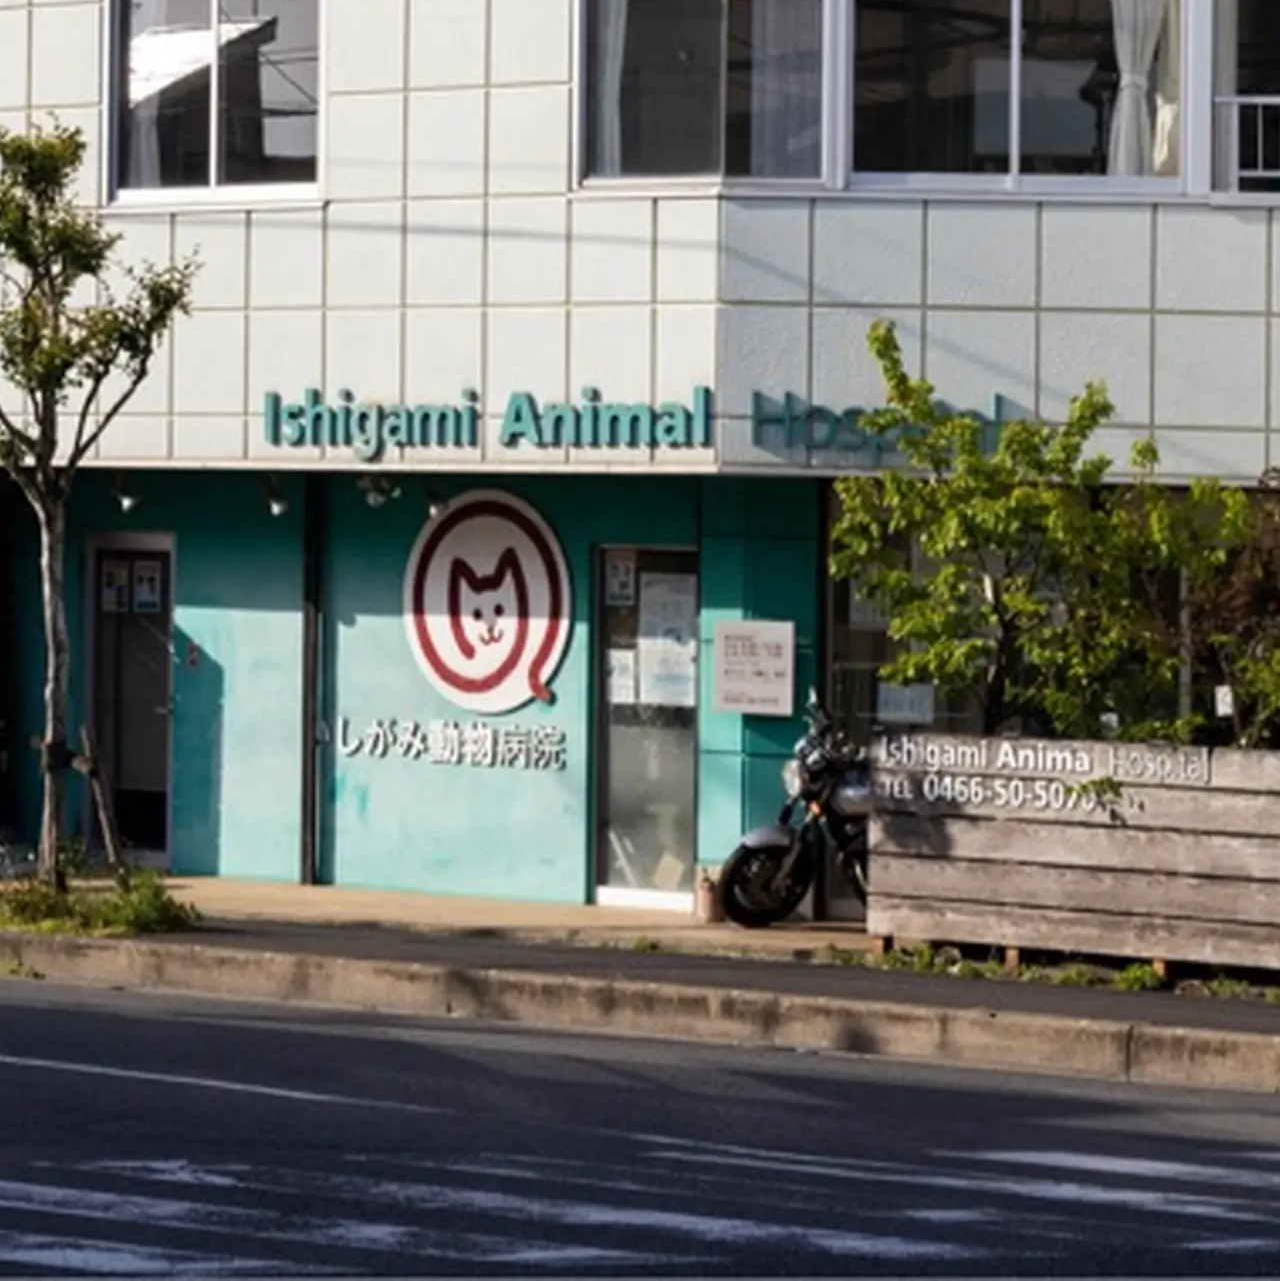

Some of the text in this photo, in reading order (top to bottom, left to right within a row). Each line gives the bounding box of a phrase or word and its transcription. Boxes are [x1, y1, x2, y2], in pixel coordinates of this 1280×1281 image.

[264, 385, 1005, 466] Ishigami Animal Hosl
[997, 740, 1094, 773] Anima
[1108, 744, 1211, 785] Hosptal
